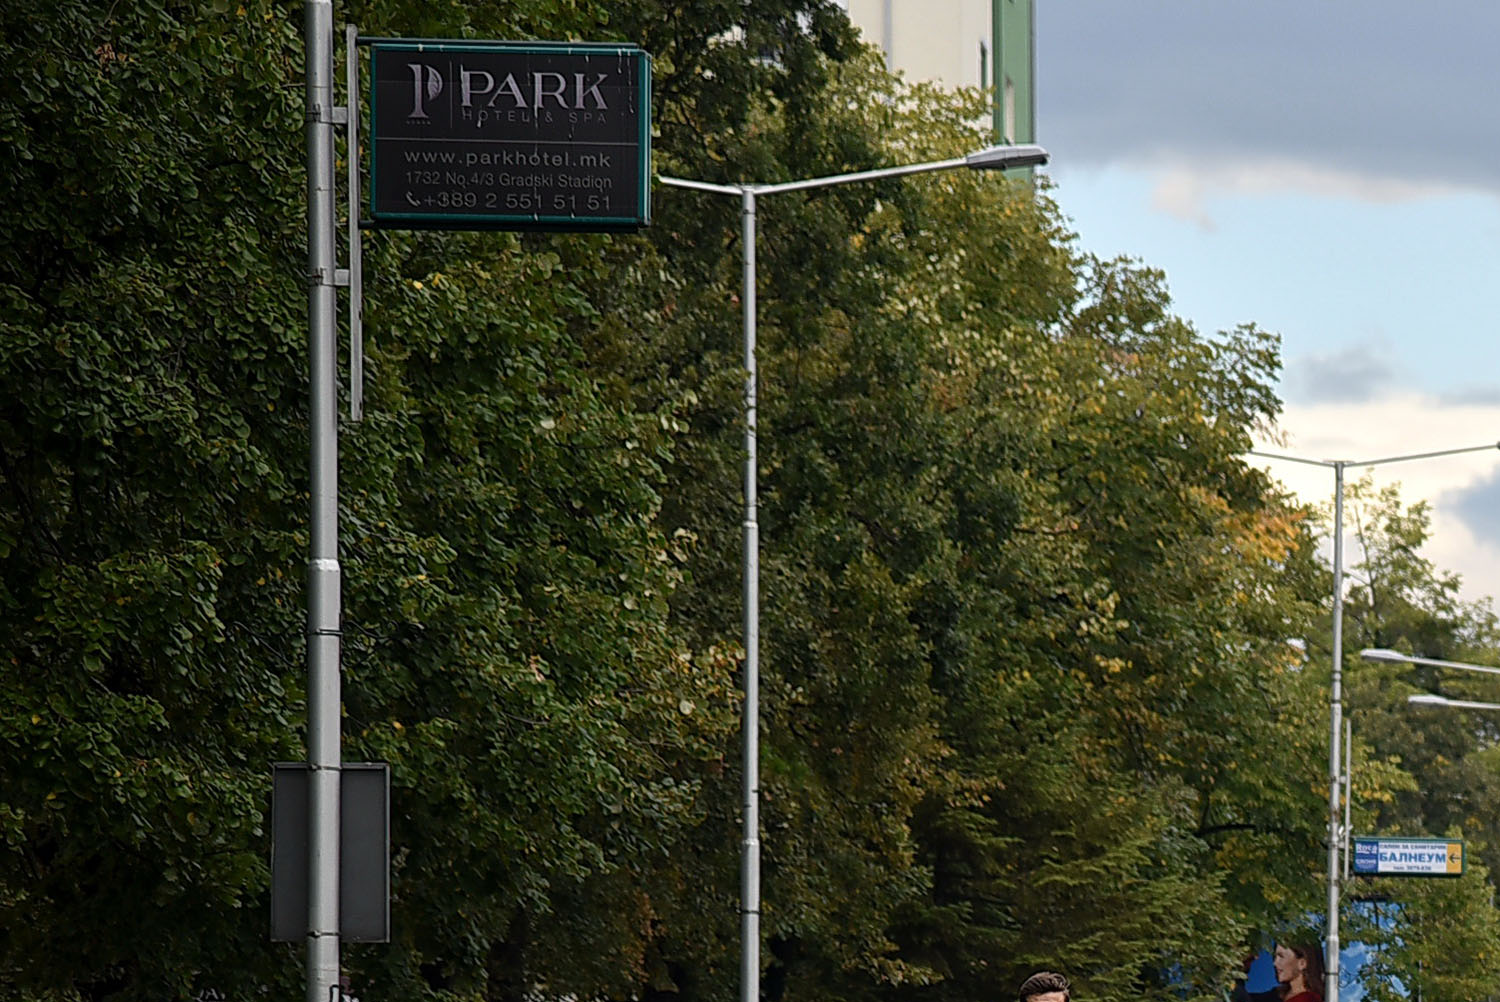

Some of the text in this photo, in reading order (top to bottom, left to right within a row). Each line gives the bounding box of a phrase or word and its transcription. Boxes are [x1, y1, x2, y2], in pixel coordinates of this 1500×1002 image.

[461, 70, 609, 110] PARK
[462, 109, 607, 124] HOTEL & SPA
[405, 151, 611, 168] www.parkhotel.mk
[500, 172, 553, 188] Gradski
[558, 173, 612, 188] Stadion
[424, 191, 611, 211] +389 2 551 51 51
[1379, 852, 1446, 863] БАЛНЕУМ
